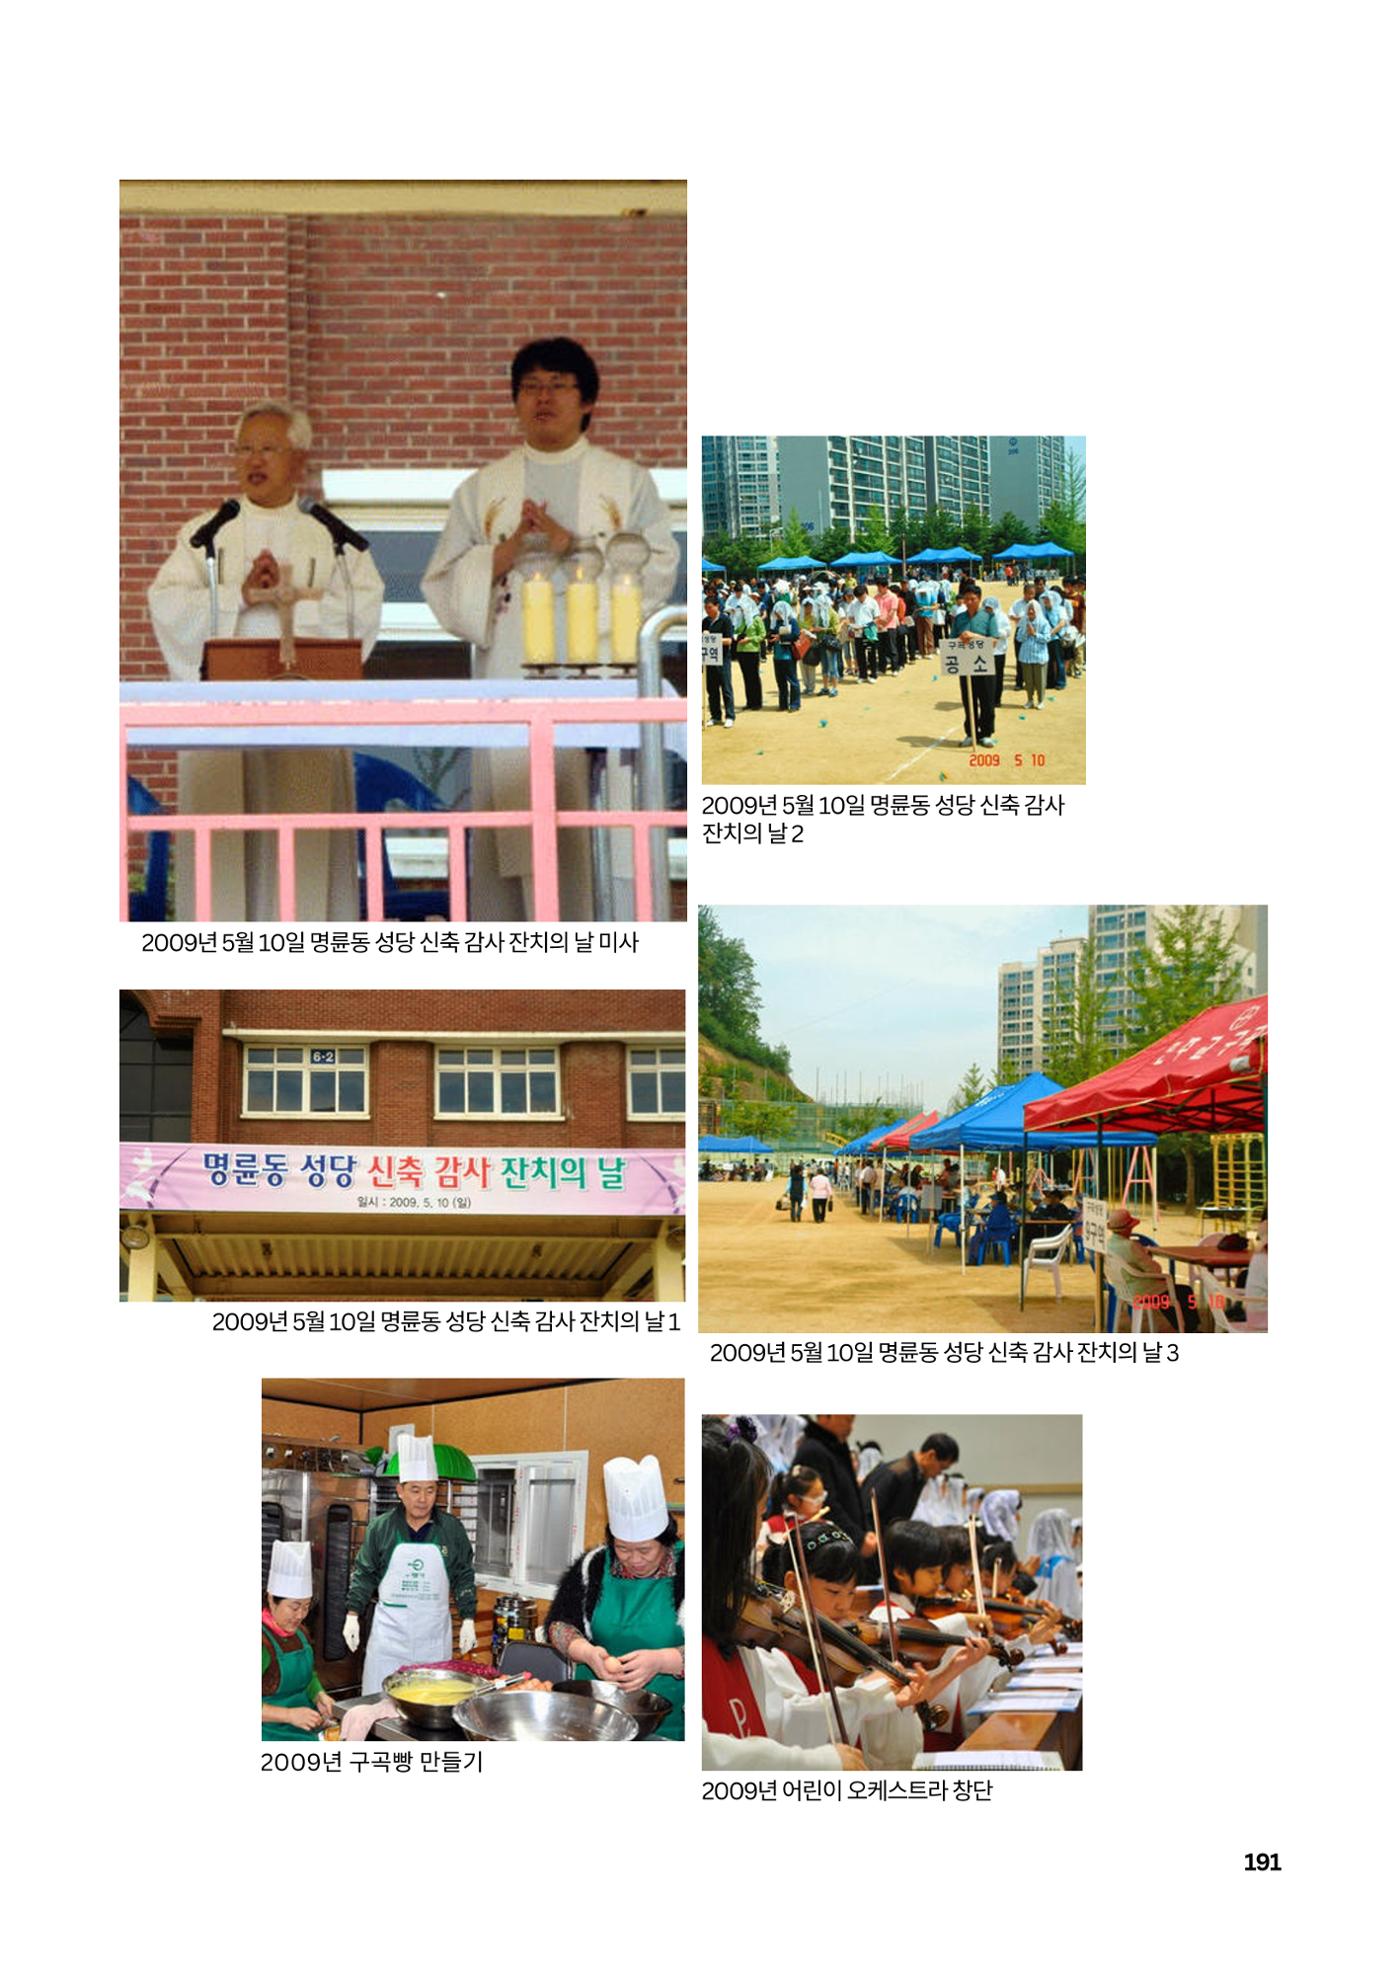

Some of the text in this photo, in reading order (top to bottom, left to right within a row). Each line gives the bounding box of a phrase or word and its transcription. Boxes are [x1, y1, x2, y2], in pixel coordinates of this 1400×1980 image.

[702, 634, 717, 644] 성당
[313, 1051, 334, 1063] 6-2
[203, 1152, 627, 1190] 명륜동 성당 신축 감사 잔치의 날
[357, 1196, 379, 1208] 일시
[437, 1198, 450, 1208] 10
[452, 1196, 472, 1209] (일)
